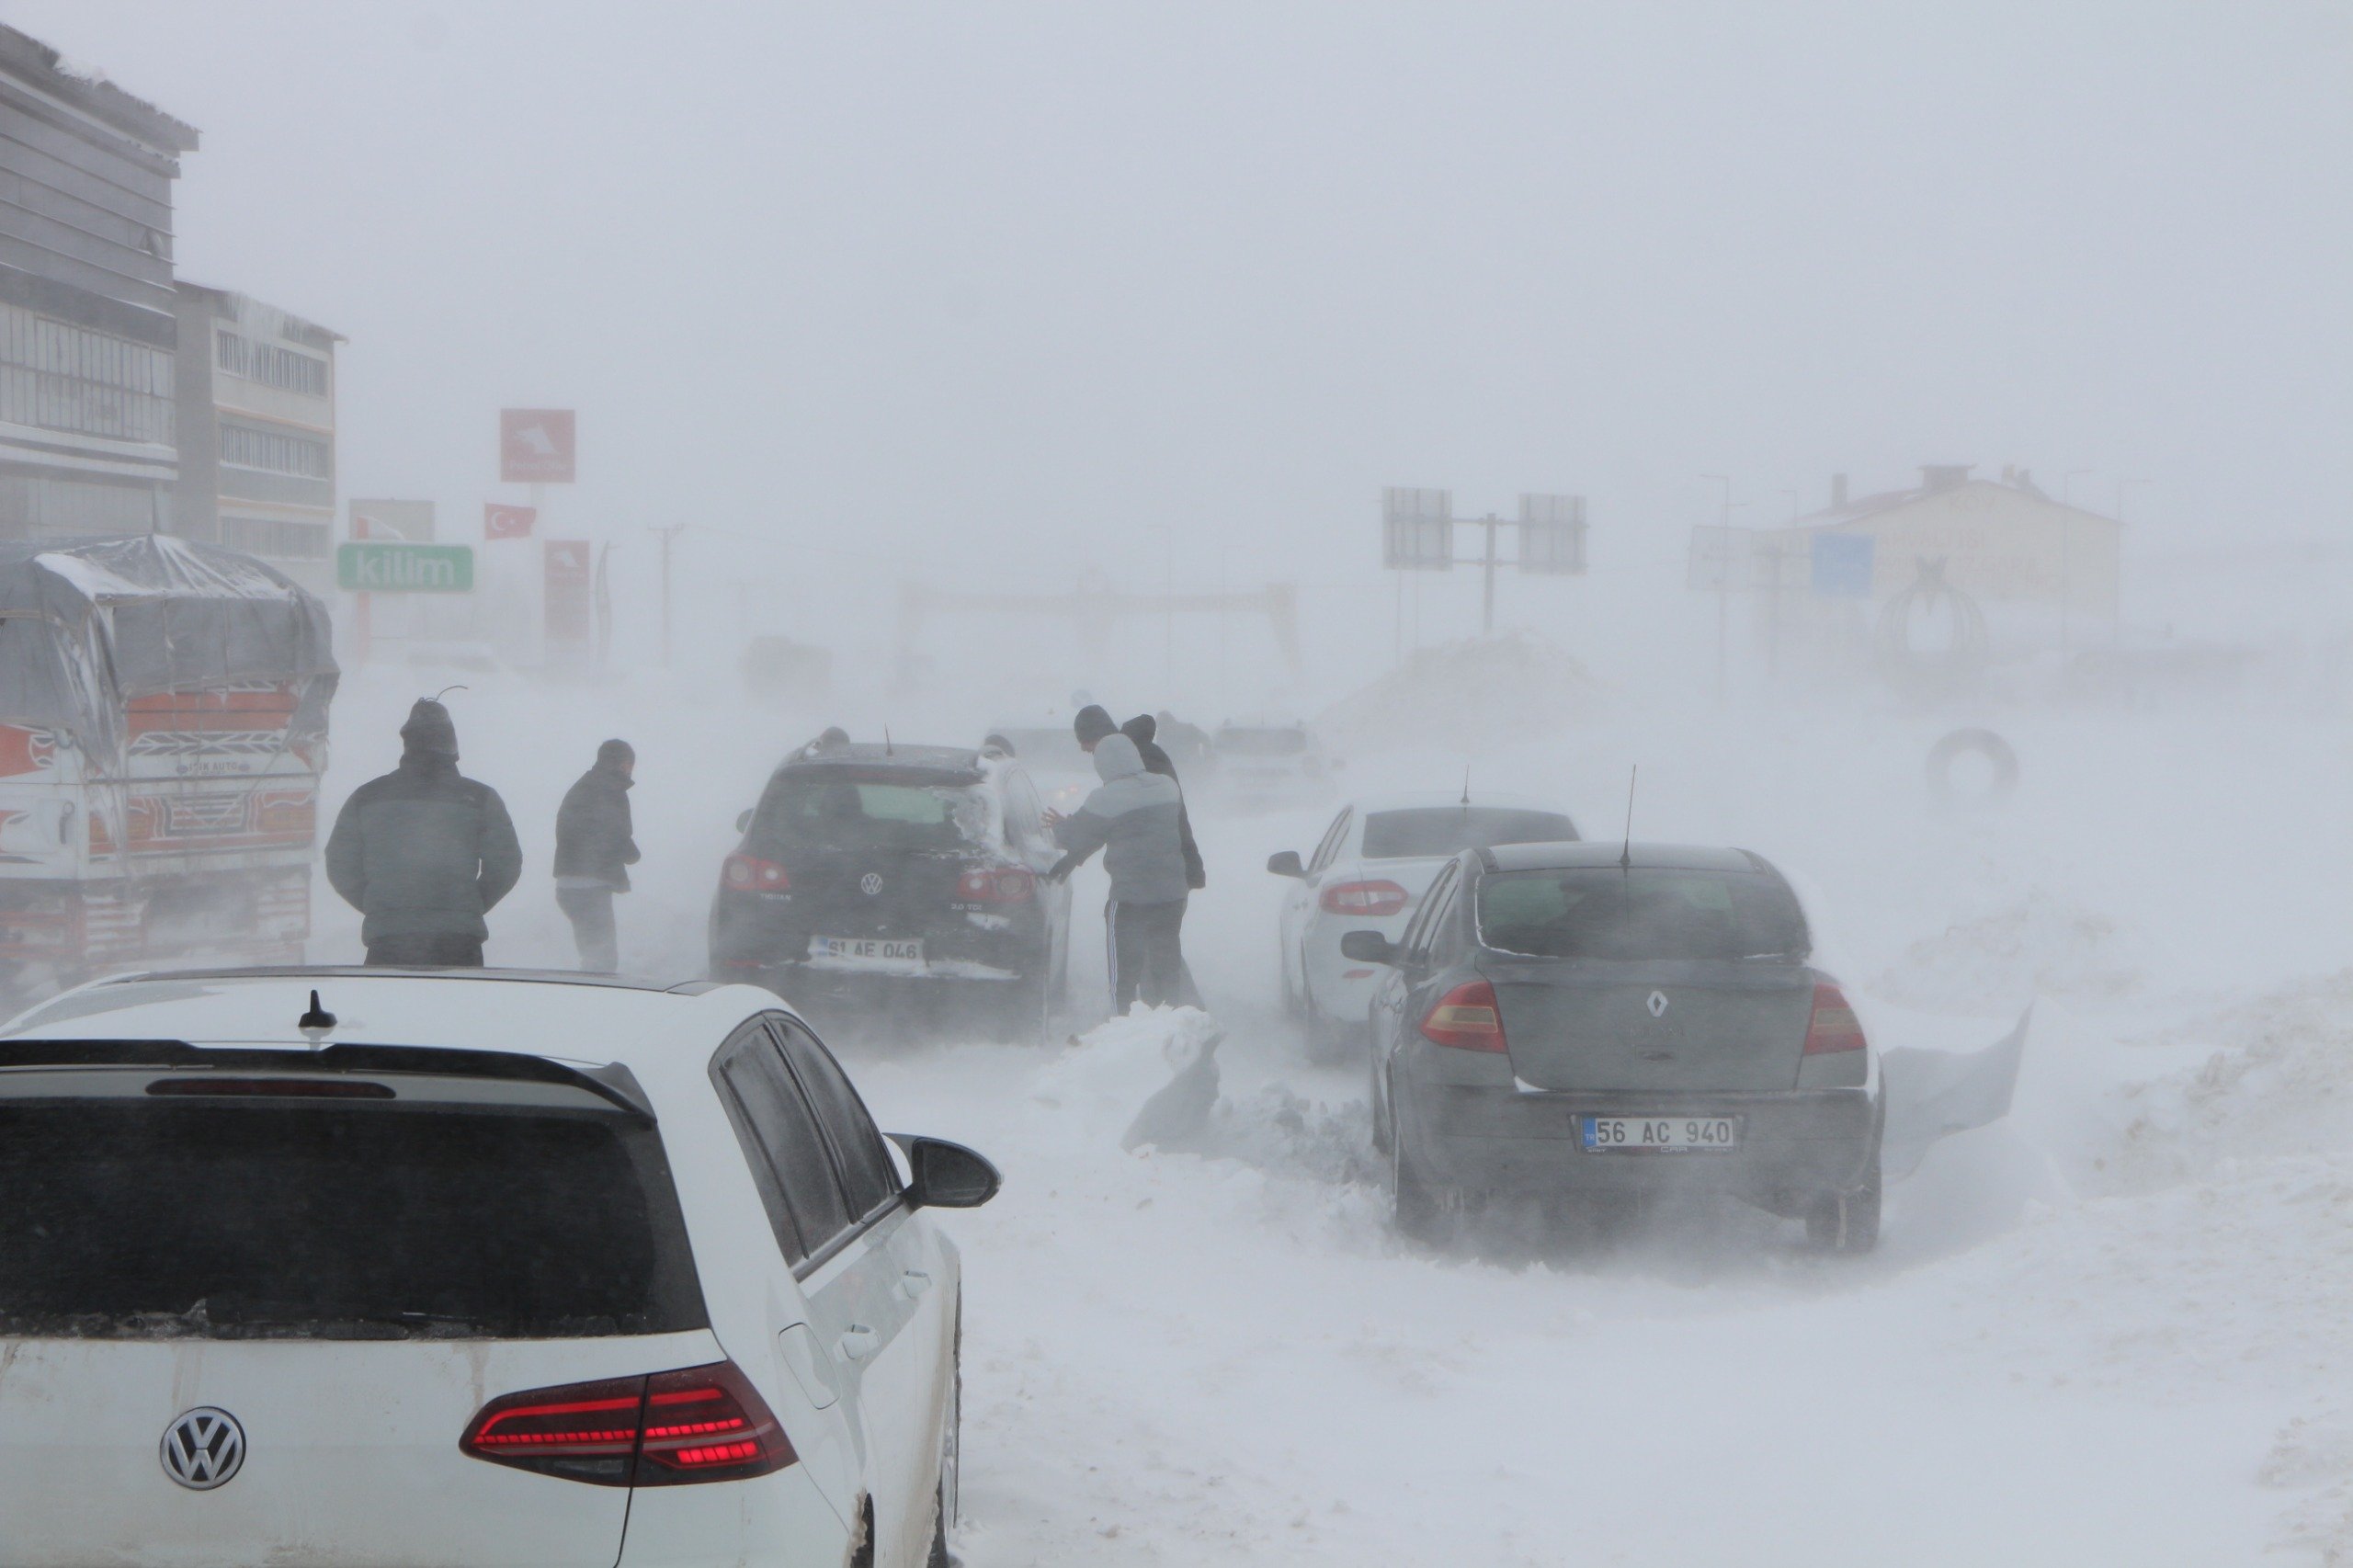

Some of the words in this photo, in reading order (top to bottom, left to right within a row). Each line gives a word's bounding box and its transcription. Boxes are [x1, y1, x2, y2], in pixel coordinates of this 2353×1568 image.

[356, 550, 454, 585] kilim
[855, 941, 876, 958] AE
[883, 943, 916, 960] 046
[1597, 1121, 1625, 1143] 56
[1642, 1121, 1670, 1143] AC
[1686, 1121, 1730, 1143] 940
